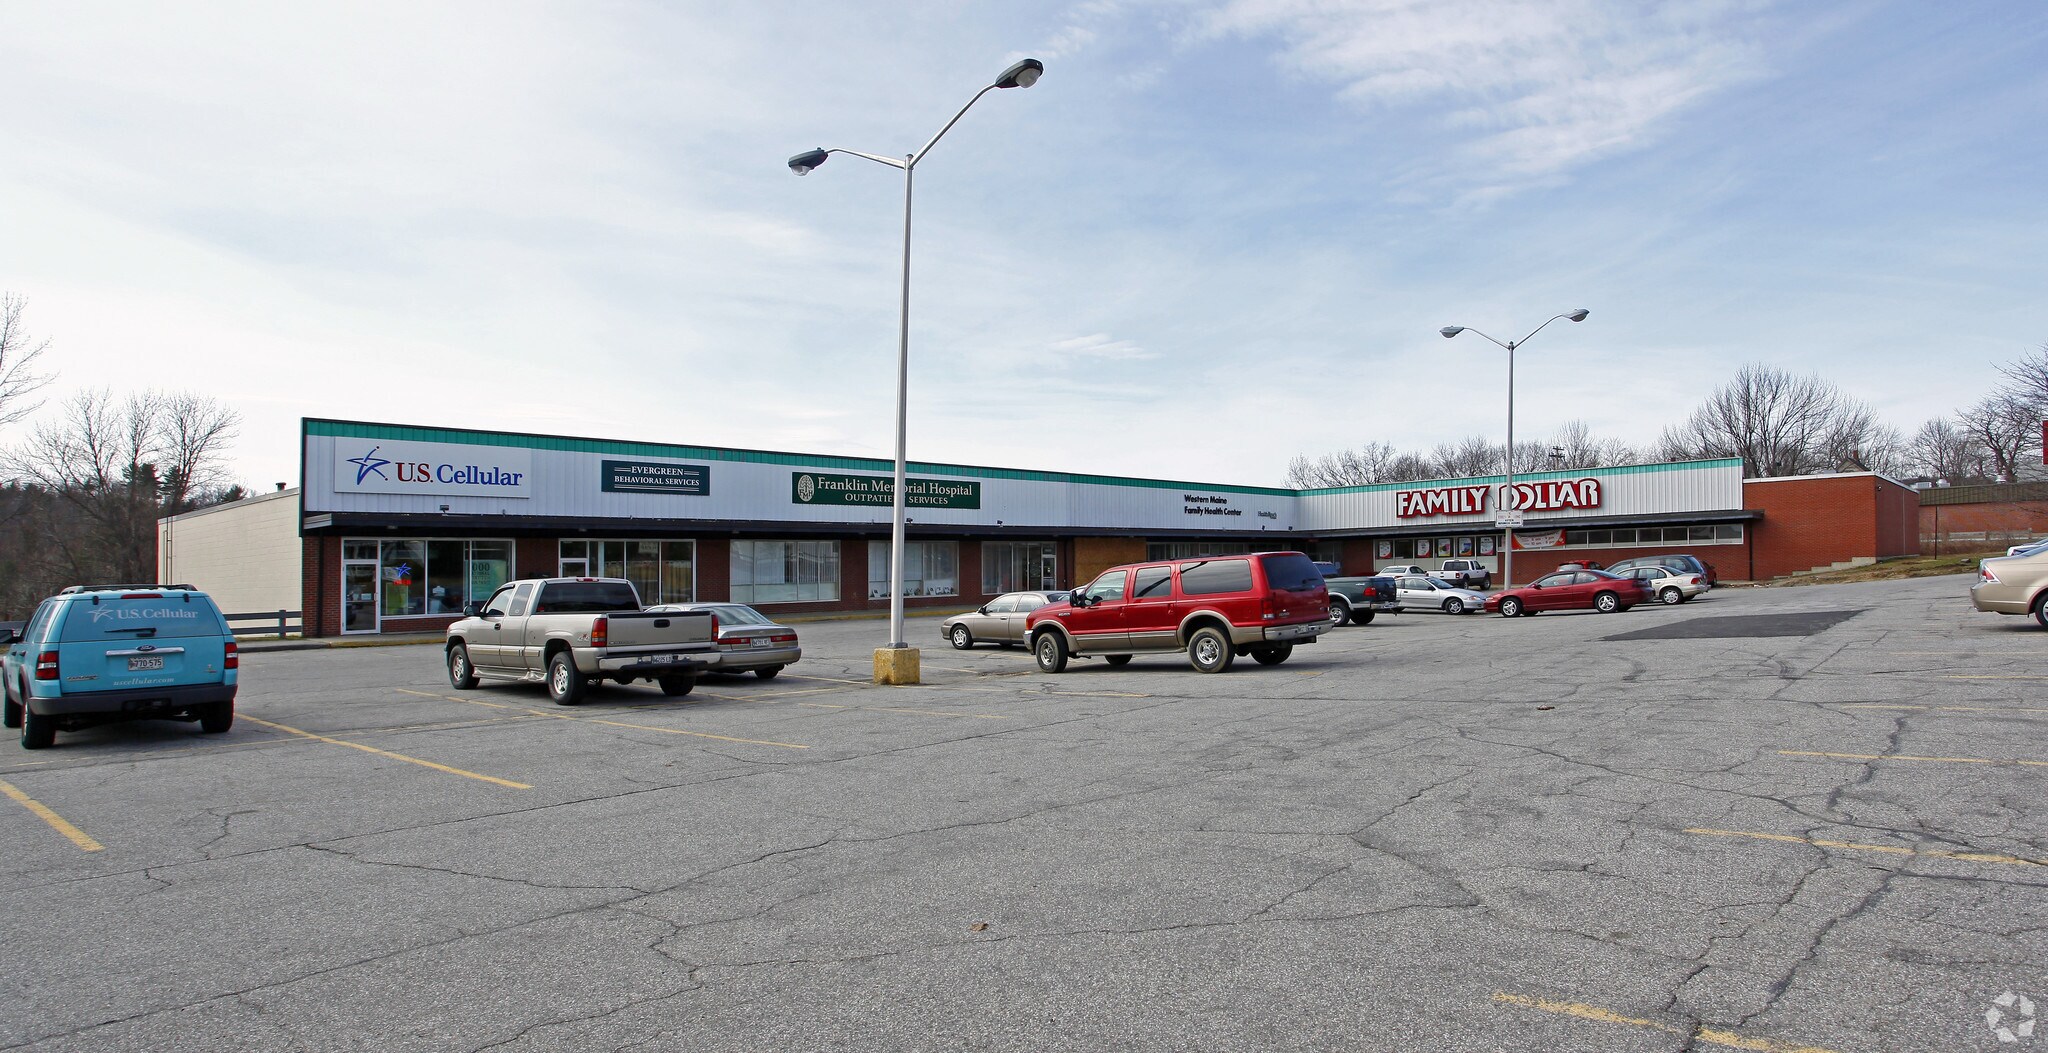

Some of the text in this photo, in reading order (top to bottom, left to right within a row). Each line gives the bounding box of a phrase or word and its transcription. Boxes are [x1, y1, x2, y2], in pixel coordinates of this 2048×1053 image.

[395, 462, 522, 486] U.S. Cellular
[631, 466, 684, 476] EVERGREEN
[614, 475, 700, 486] BEHAVIORAL SERVICES
[817, 476, 868, 491] Franklin
[929, 482, 973, 498] Hospital
[908, 495, 949, 505] SERVICES
[1184, 494, 1228, 504] Western Maine
[1397, 478, 1600, 518] FAMILY DOLLAR
[1184, 506, 1242, 516] Family Health Center
[116, 608, 198, 620] U.S. Cellular
[113, 677, 175, 686] uscellular.com
